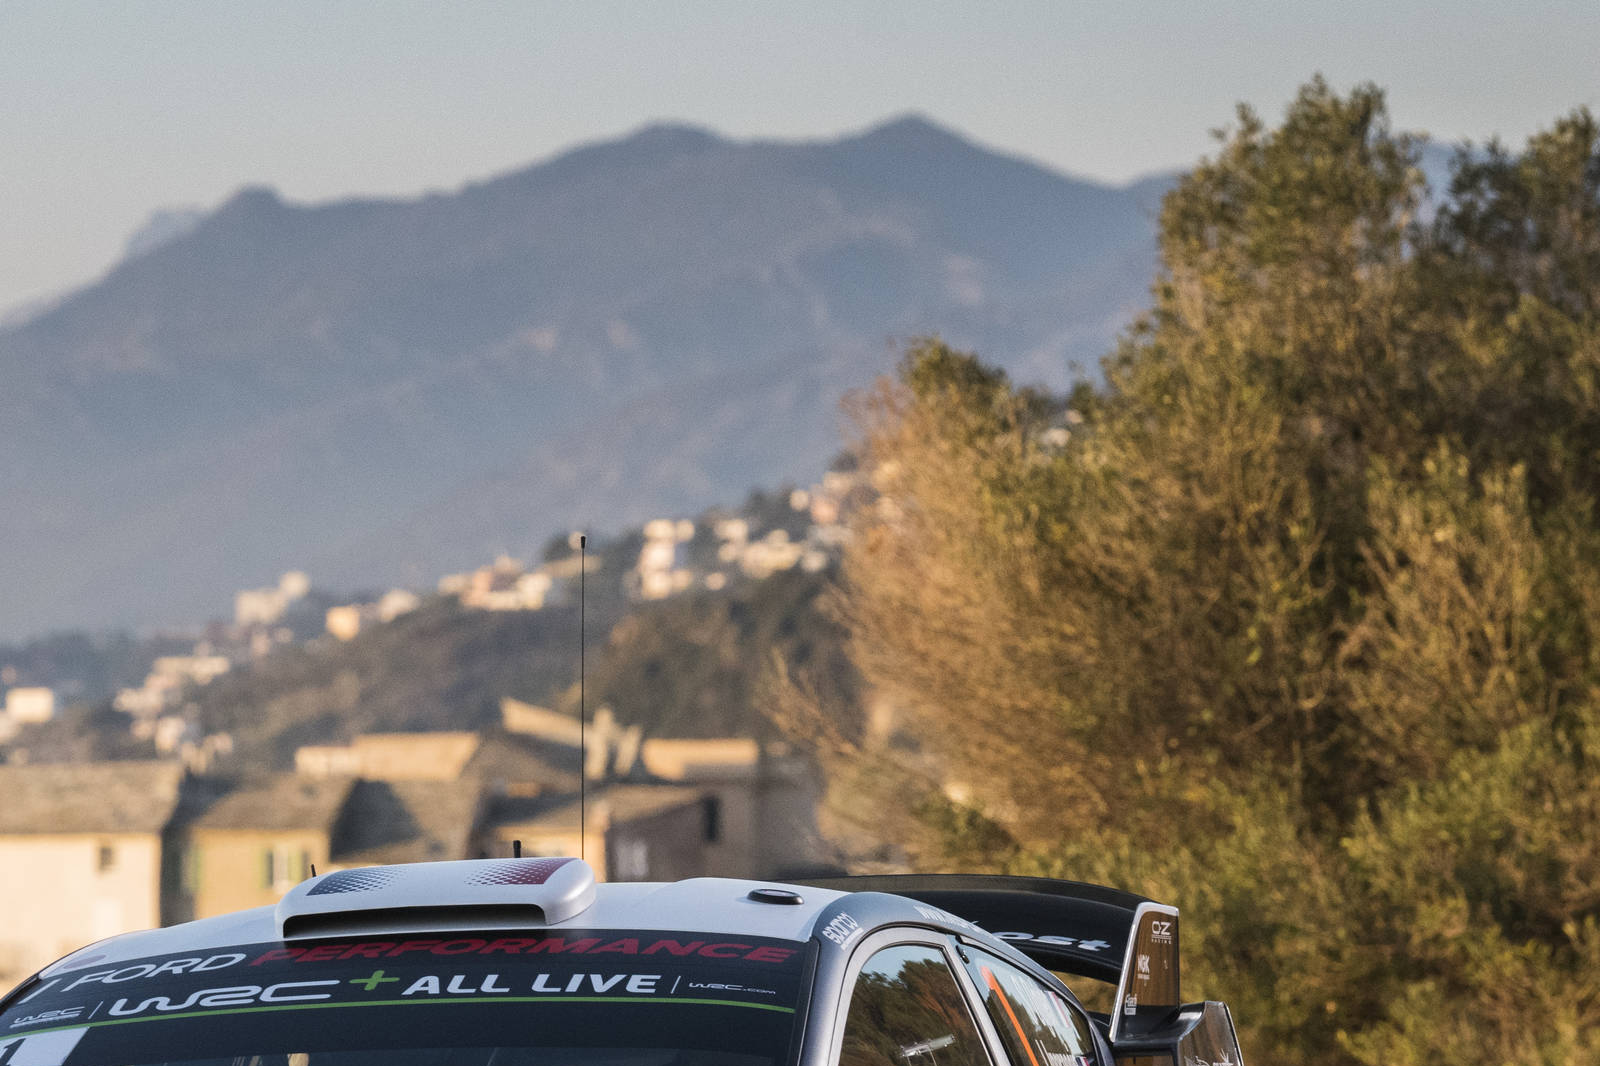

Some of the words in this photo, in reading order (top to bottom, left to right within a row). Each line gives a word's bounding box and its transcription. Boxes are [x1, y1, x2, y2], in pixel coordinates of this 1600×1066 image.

[1152, 921, 1171, 935] OZ
[61, 954, 246, 992] FORD
[249, 938, 799, 967] PERFORMANCE
[401, 974, 510, 996] ALL
[531, 974, 662, 993] LIVE
